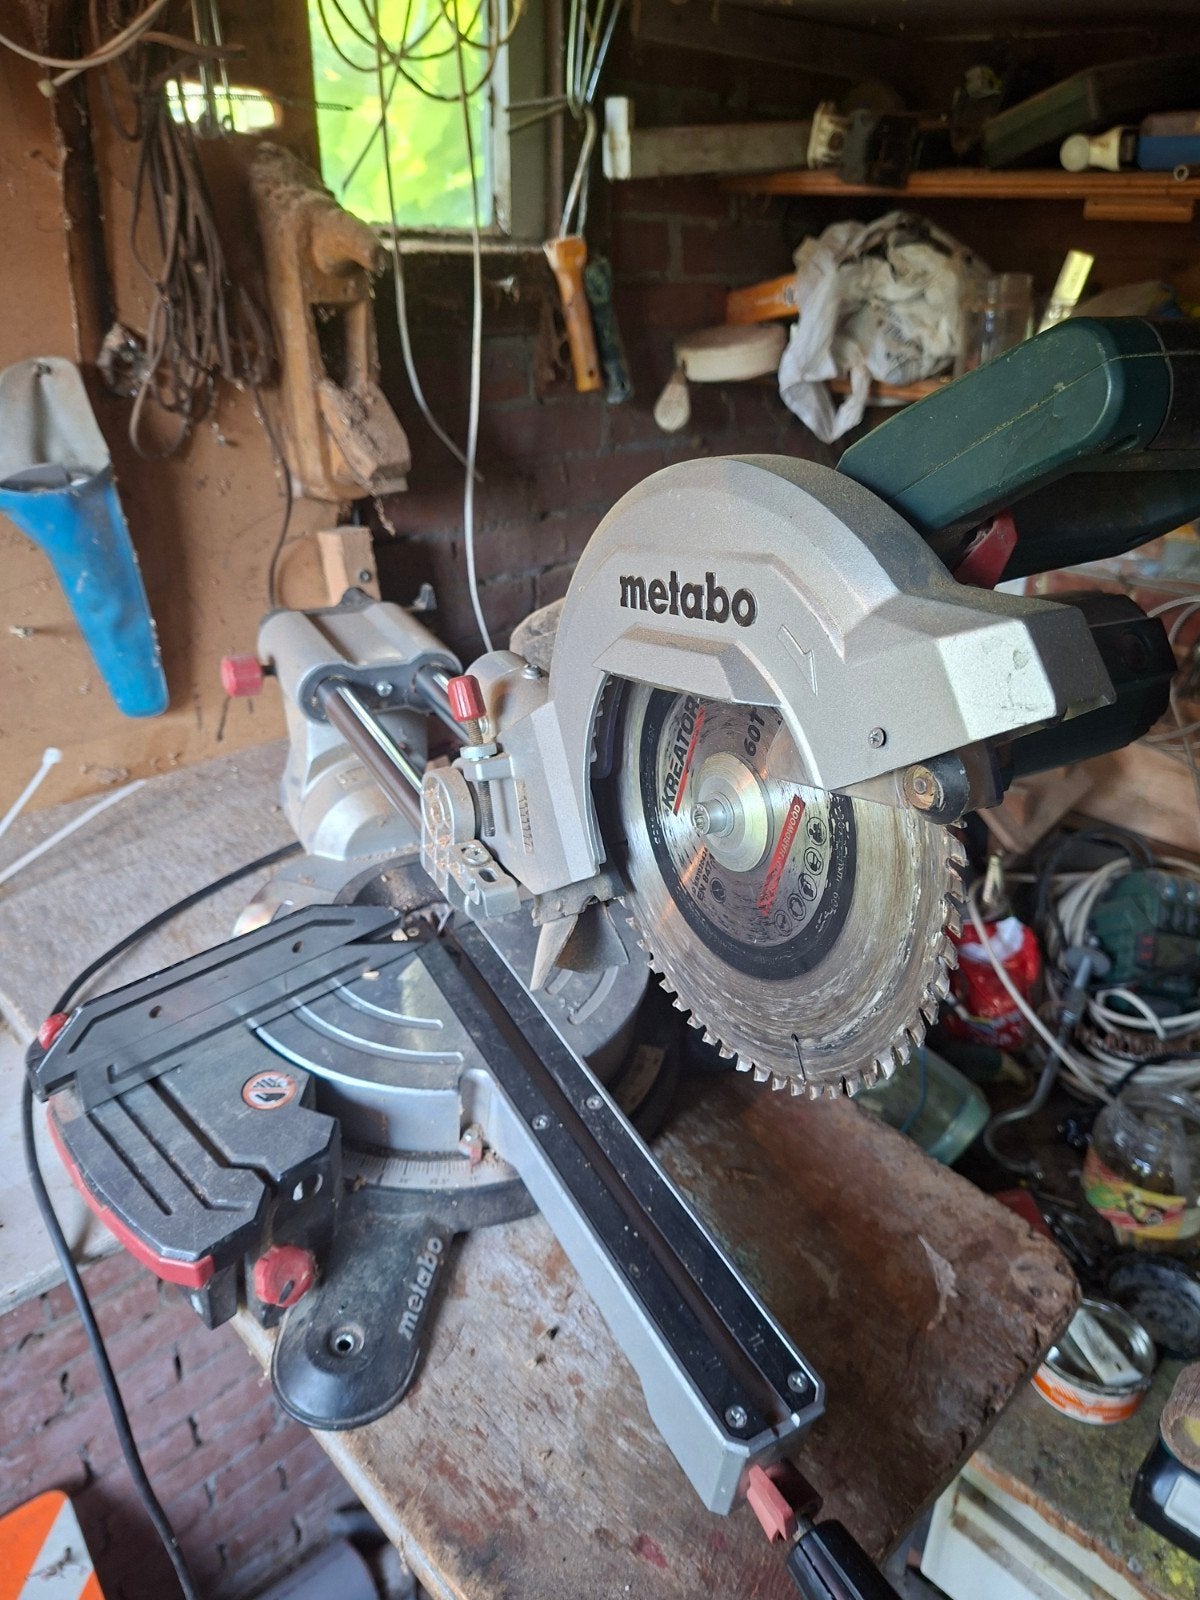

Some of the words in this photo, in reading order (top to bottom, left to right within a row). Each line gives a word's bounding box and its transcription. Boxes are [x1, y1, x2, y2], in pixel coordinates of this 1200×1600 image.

[619, 569, 758, 627] metabo
[661, 695, 701, 811] KREATOR
[744, 705, 766, 756] 60T
[779, 803, 800, 859] HARDWOOD
[398, 1236, 442, 1341] metabo
